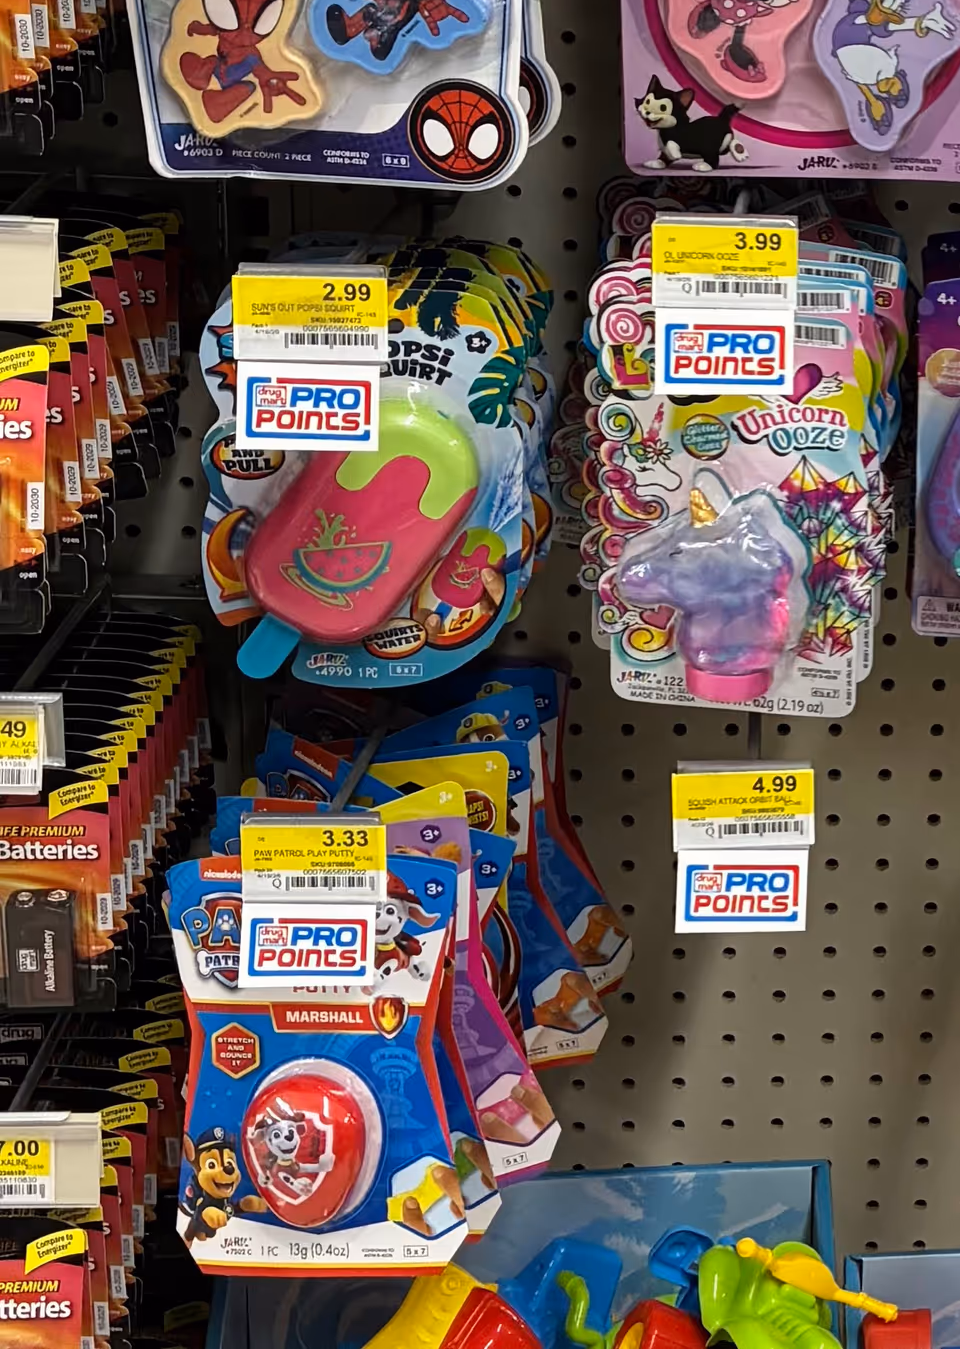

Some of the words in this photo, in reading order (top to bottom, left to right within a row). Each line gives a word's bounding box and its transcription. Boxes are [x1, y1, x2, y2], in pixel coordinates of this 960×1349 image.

[734, 232, 782, 252] 3.99
[323, 282, 371, 303] 2.99
[706, 332, 775, 355] PRO
[674, 355, 774, 376] POINTS
[289, 386, 360, 410] PRO
[256, 409, 360, 432] POINTS
[736, 406, 848, 438] Unicorn
[770, 424, 845, 450] Ooze
[224, 457, 275, 472] PULL
[30, 488, 39, 522] 10-2030
[58, 785, 87, 798] Compare
[752, 776, 798, 794] 4.99
[21, 826, 84, 836] PREMIUM
[322, 830, 369, 848] 3.33
[724, 872, 790, 894] PRO
[694, 894, 790, 913] POINTS
[291, 926, 358, 949] PRO
[257, 948, 357, 969] POINTS
[286, 1009, 364, 1025] MARSHALL
[289, 1242, 308, 1260] 13g
[312, 1242, 351, 1260] (0.4oz)
